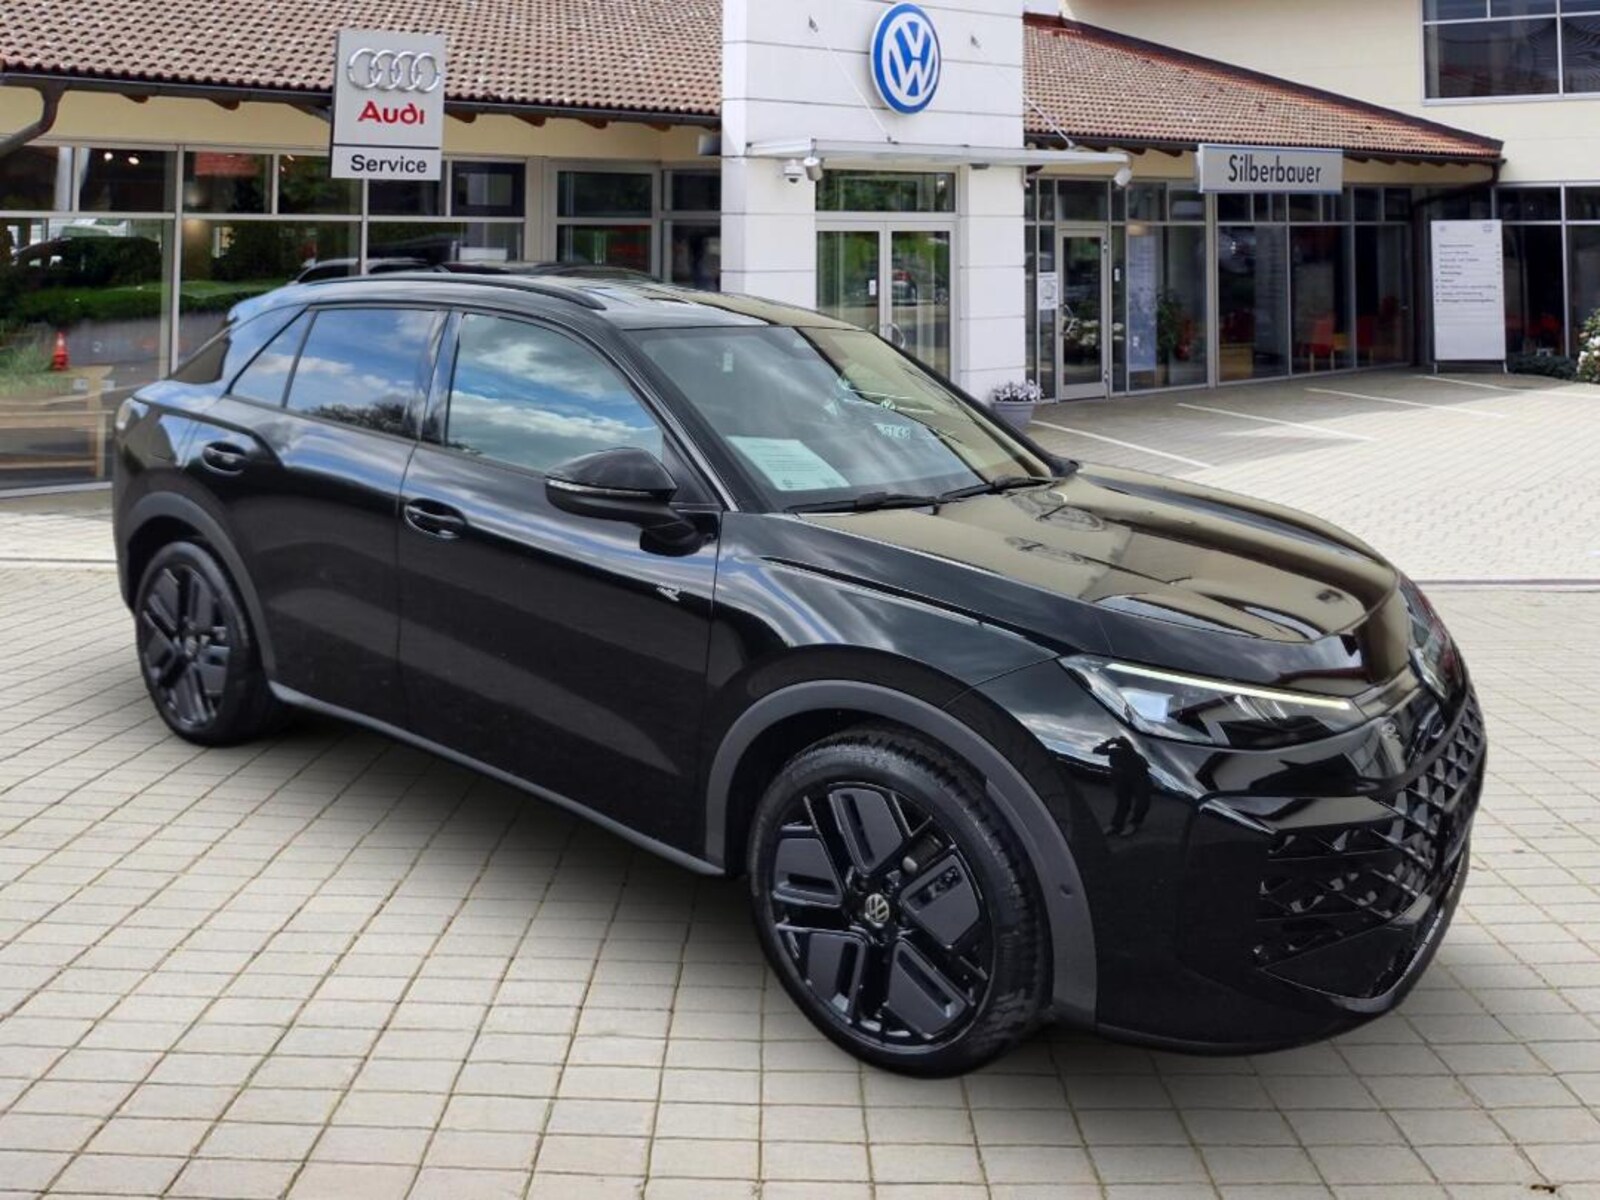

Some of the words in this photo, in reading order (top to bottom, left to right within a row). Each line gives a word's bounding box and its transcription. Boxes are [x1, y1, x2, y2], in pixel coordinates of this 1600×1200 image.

[876, 5, 938, 111] VW
[358, 101, 425, 125] Audi
[351, 154, 427, 173] Service
[1228, 154, 1321, 183] Silberbauer
